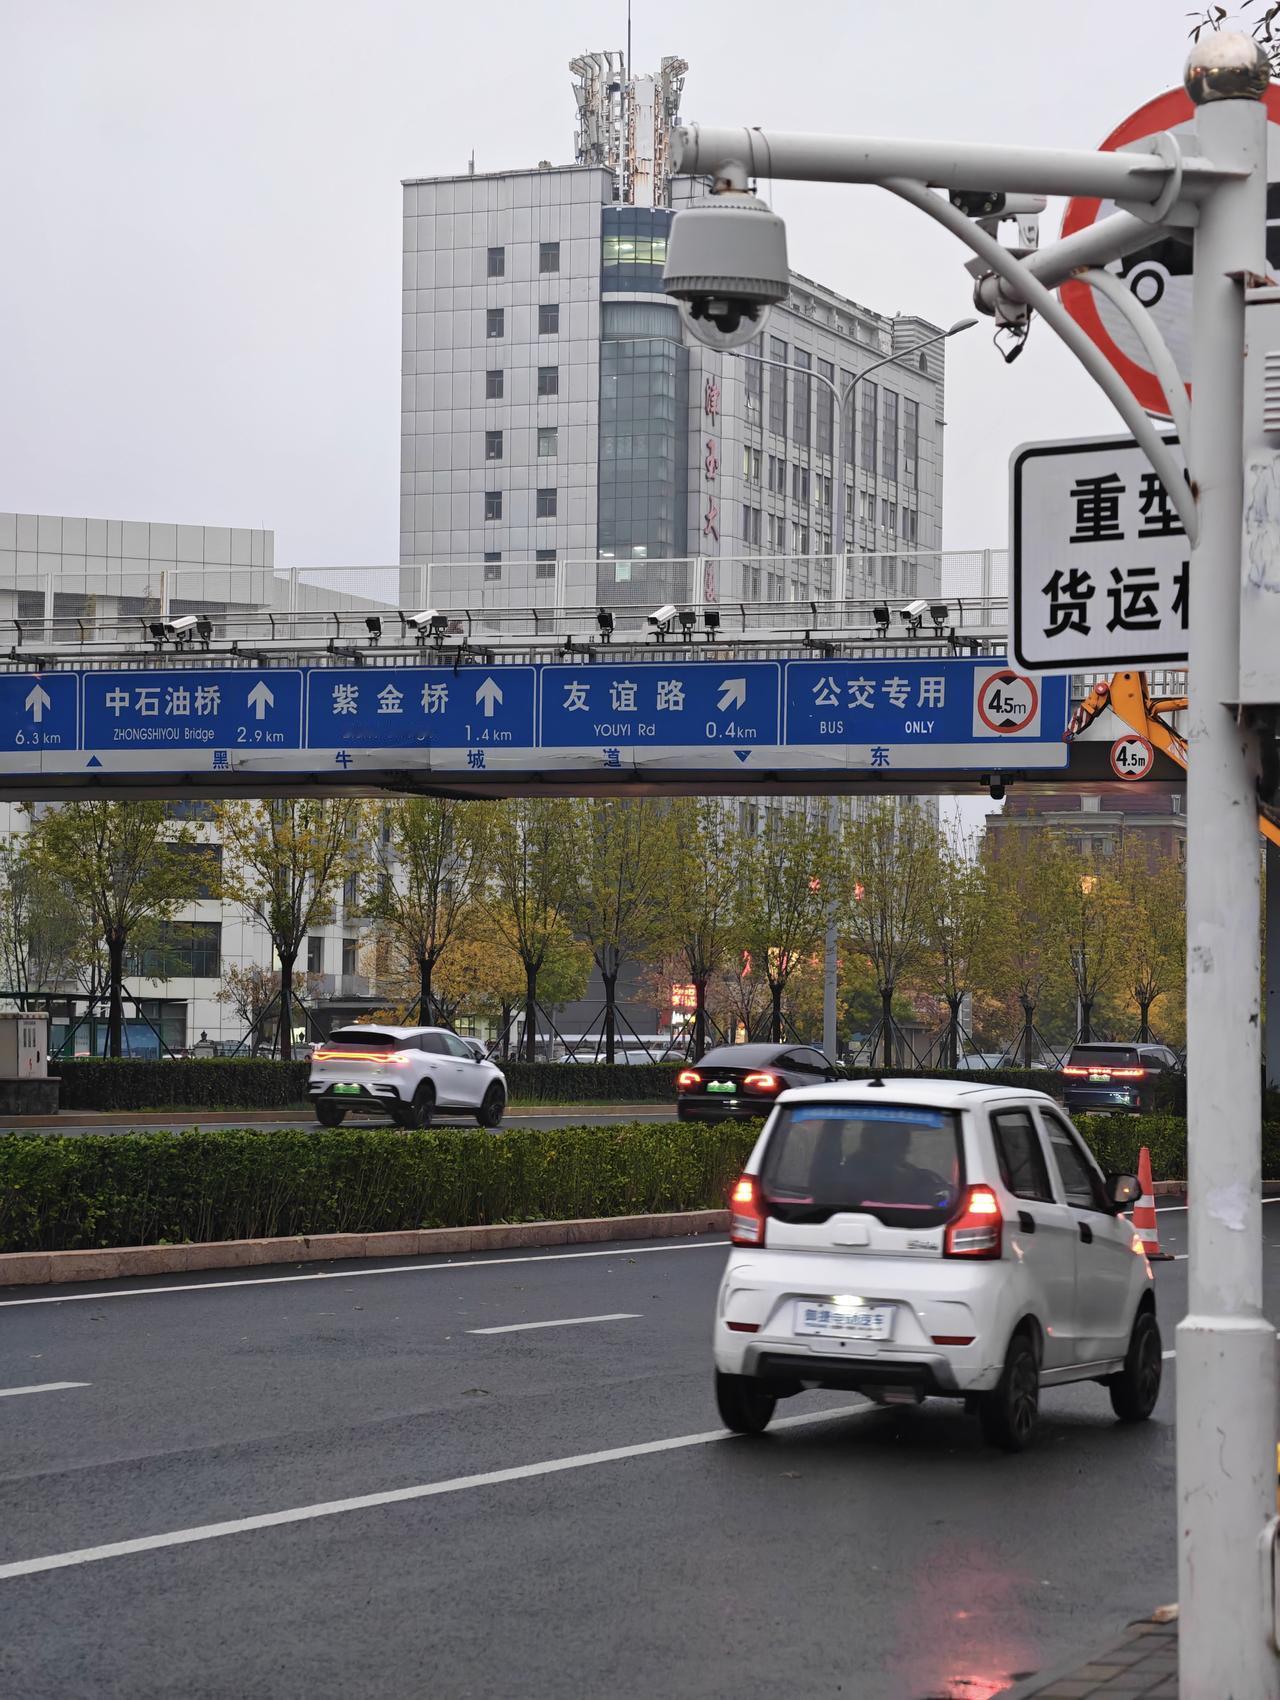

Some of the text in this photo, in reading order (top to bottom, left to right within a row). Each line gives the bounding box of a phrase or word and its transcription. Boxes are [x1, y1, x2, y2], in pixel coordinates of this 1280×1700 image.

[1070, 473, 1186, 543] 重型
[105, 685, 221, 717] 中石油桥
[332, 683, 449, 715] 紫金桥
[562, 679, 686, 712] 友谊路
[811, 676, 946, 709] 公交专用
[15, 730, 61, 745] 6.3 km
[113, 727, 215, 741] ZHONGSHIYOU Bridge
[237, 727, 284, 743] 2.9 km
[464, 725, 512, 741] 1.4 km
[594, 723, 656, 737] YOUYI Rd
[820, 721, 935, 734] BUS ONLY
[870, 747, 890, 767] 东
[1116, 745, 1146, 768] 4.5m
